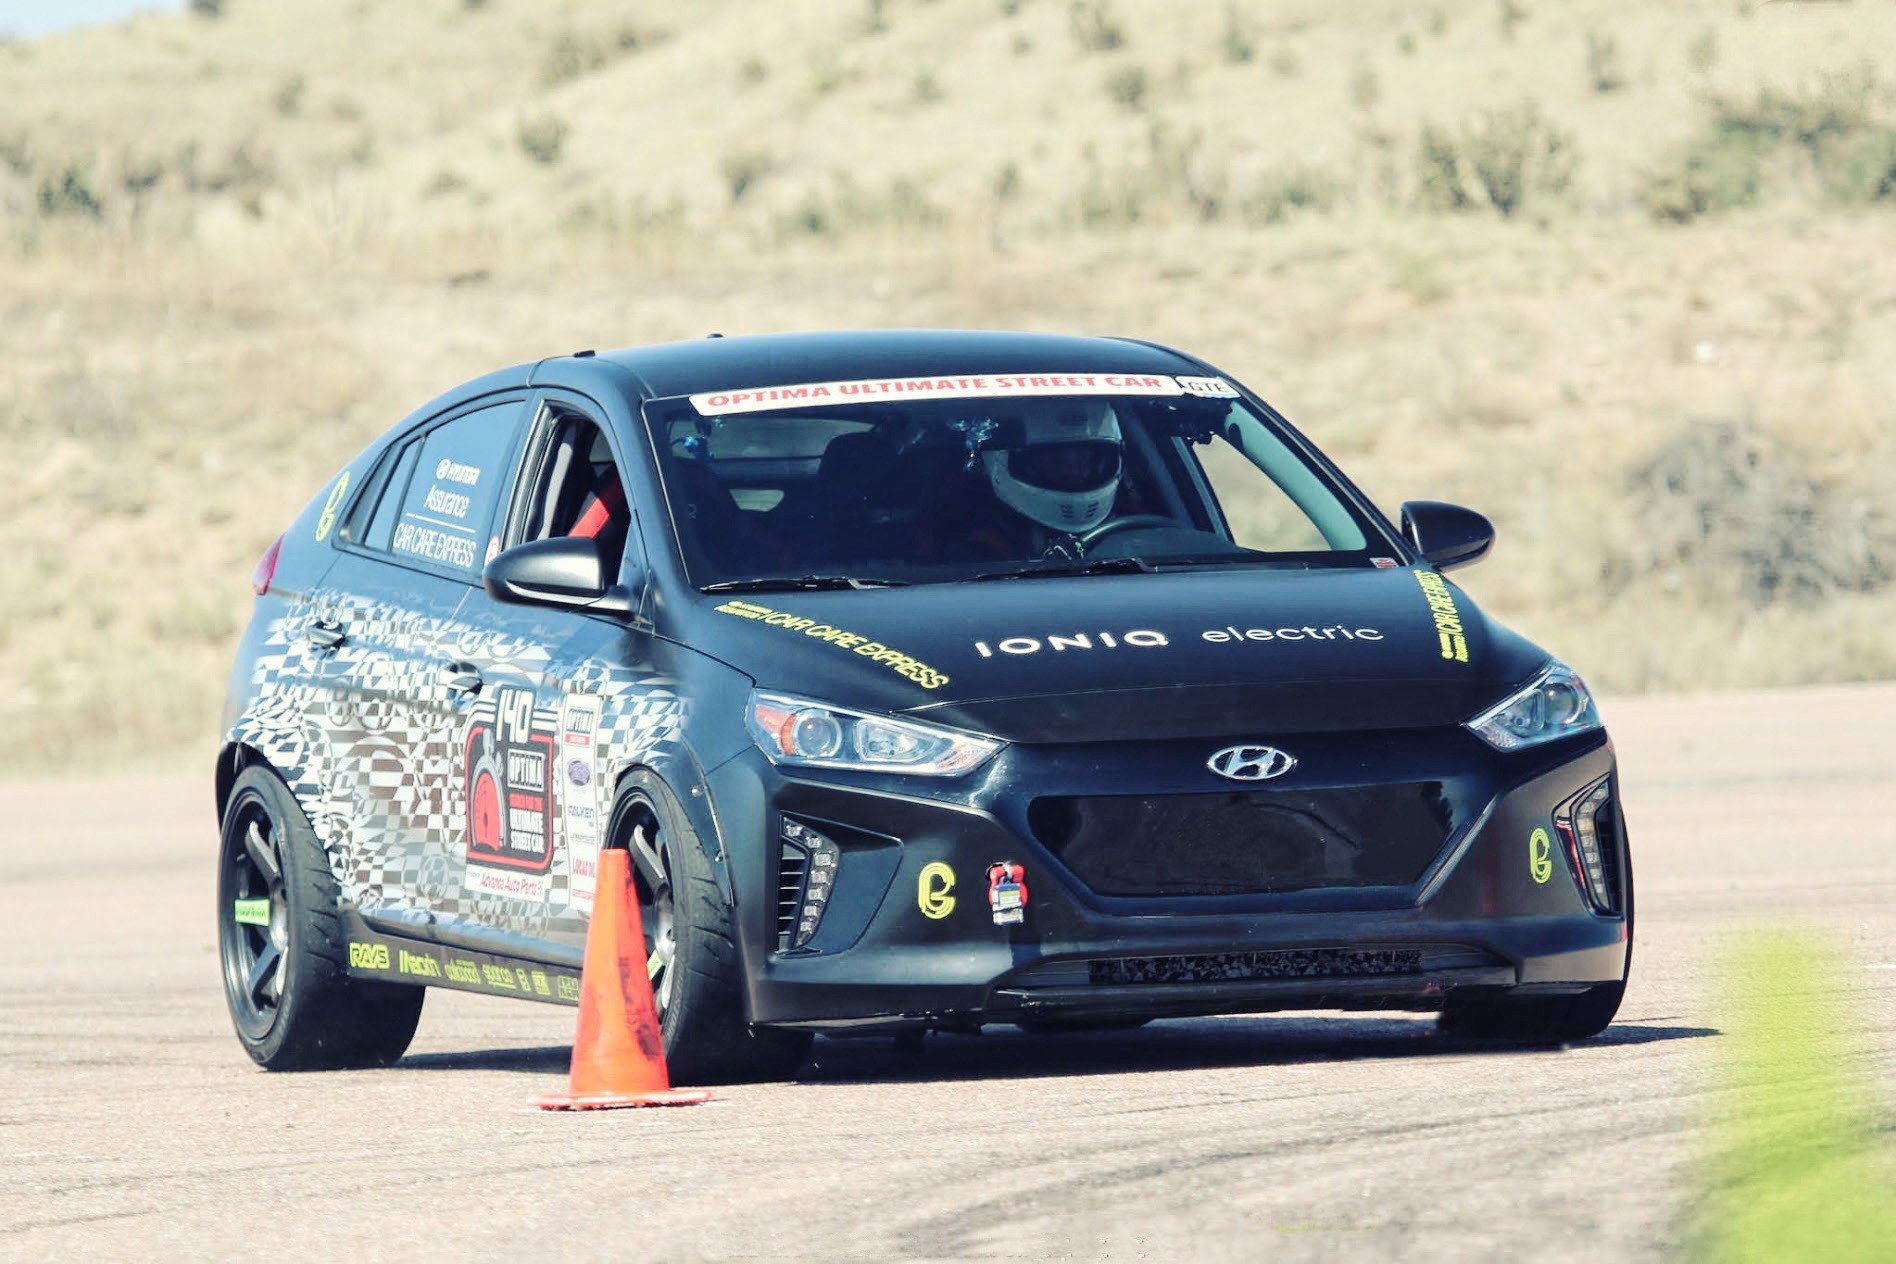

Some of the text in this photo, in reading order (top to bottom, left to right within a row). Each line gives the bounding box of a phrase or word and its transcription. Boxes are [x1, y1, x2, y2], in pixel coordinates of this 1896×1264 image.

[707, 376, 1163, 407] OPTIMA ULTIMATE STREET CAR
[1187, 380, 1226, 394] GTE
[424, 484, 470, 519] Assurance
[393, 522, 415, 551] CAR
[411, 527, 439, 558] CARE
[434, 533, 477, 568] EXPRESS
[764, 612, 950, 690] CAR CARE EXPRESS
[974, 625, 1385, 658] IONIQ electric
[496, 689, 534, 743] 140
[509, 755, 543, 787] OPTIMA
[504, 875, 520, 893] Auto
[520, 878, 538, 896] Parts
[350, 942, 390, 969] RAYS
